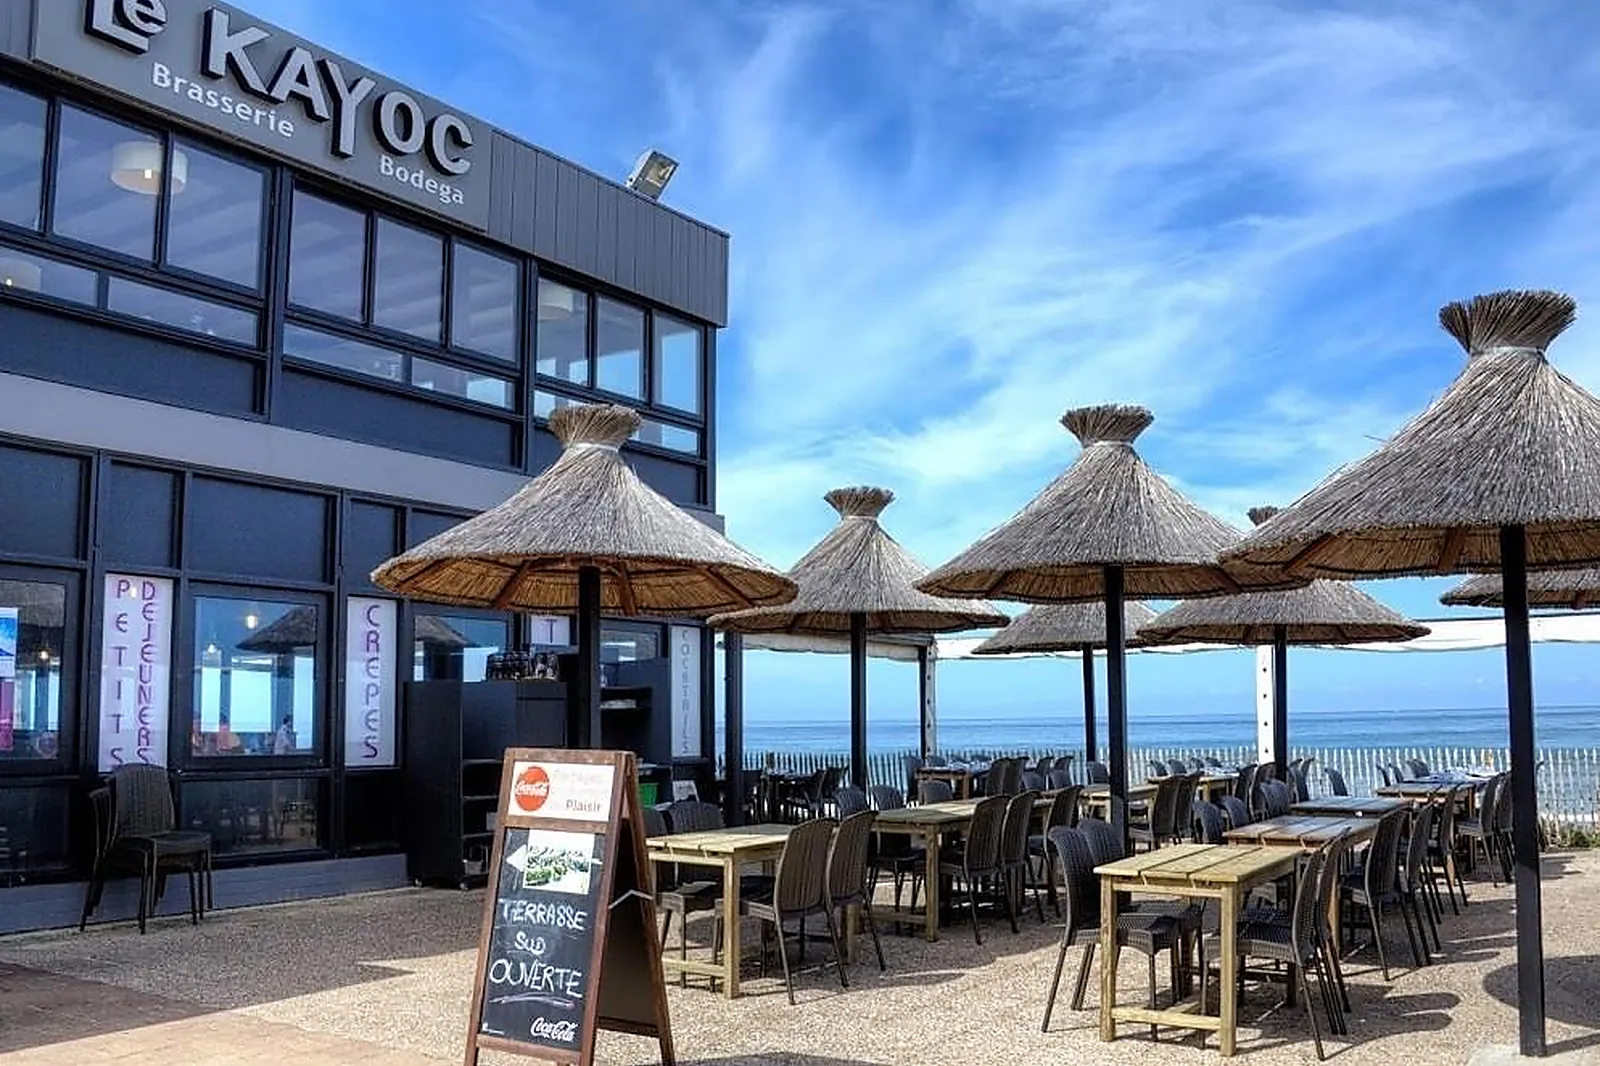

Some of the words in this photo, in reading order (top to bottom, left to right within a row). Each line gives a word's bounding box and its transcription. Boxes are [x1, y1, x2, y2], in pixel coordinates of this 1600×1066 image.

[152, 62, 295, 138] Brasserie
[203, 7, 474, 176] KAYOC
[380, 153, 464, 205] Bodega
[109, 579, 130, 766] PETITS
[136, 580, 156, 764] DEJEUNERS
[362, 604, 381, 759] CREPES
[565, 799, 601, 812] Plaisir
[498, 898, 588, 931] TERRASSE
[489, 958, 583, 998] OUVERTE
